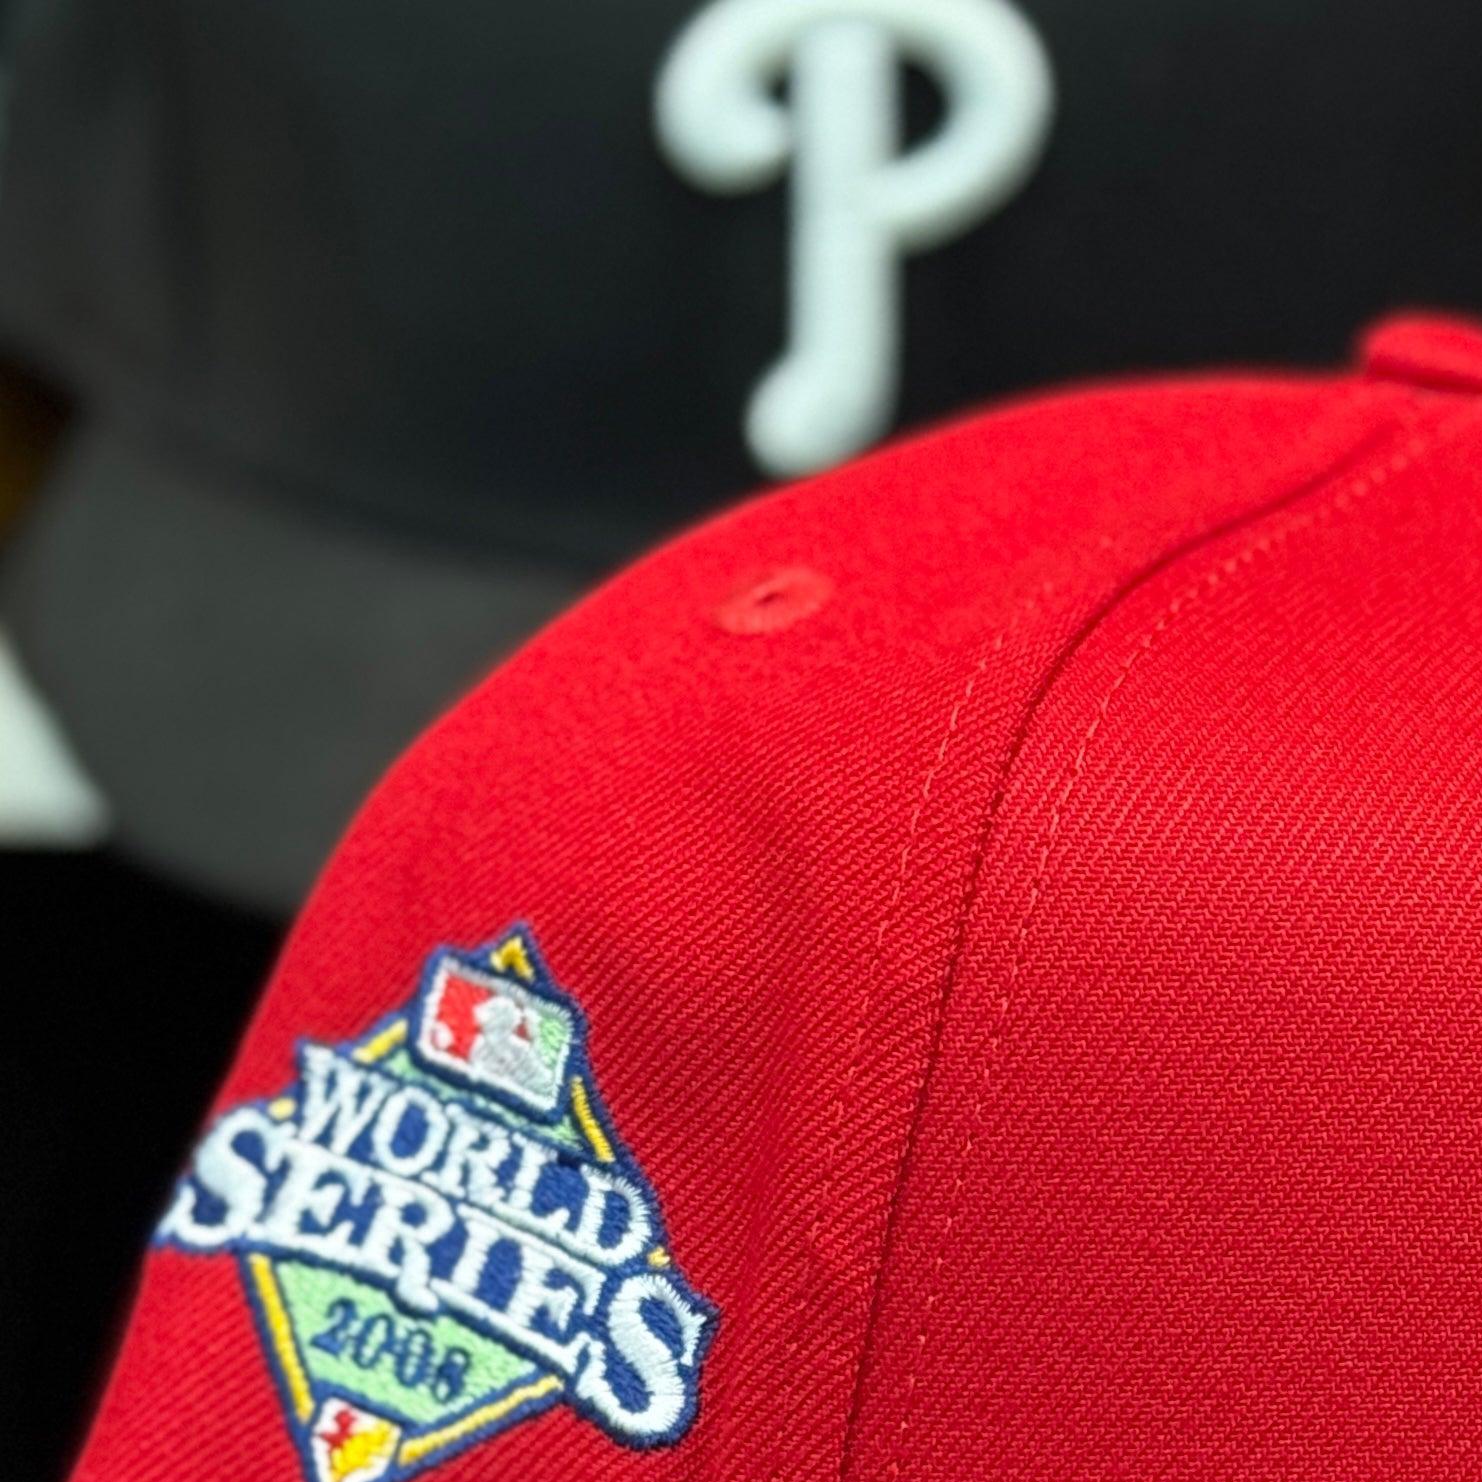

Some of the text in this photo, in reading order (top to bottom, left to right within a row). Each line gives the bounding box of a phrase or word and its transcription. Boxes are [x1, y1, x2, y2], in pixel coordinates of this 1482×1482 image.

[652, 0, 1056, 474] P
[156, 1106, 708, 1437] SERIES
[296, 1043, 653, 1268] WORLD
[311, 1297, 472, 1403] 2008
